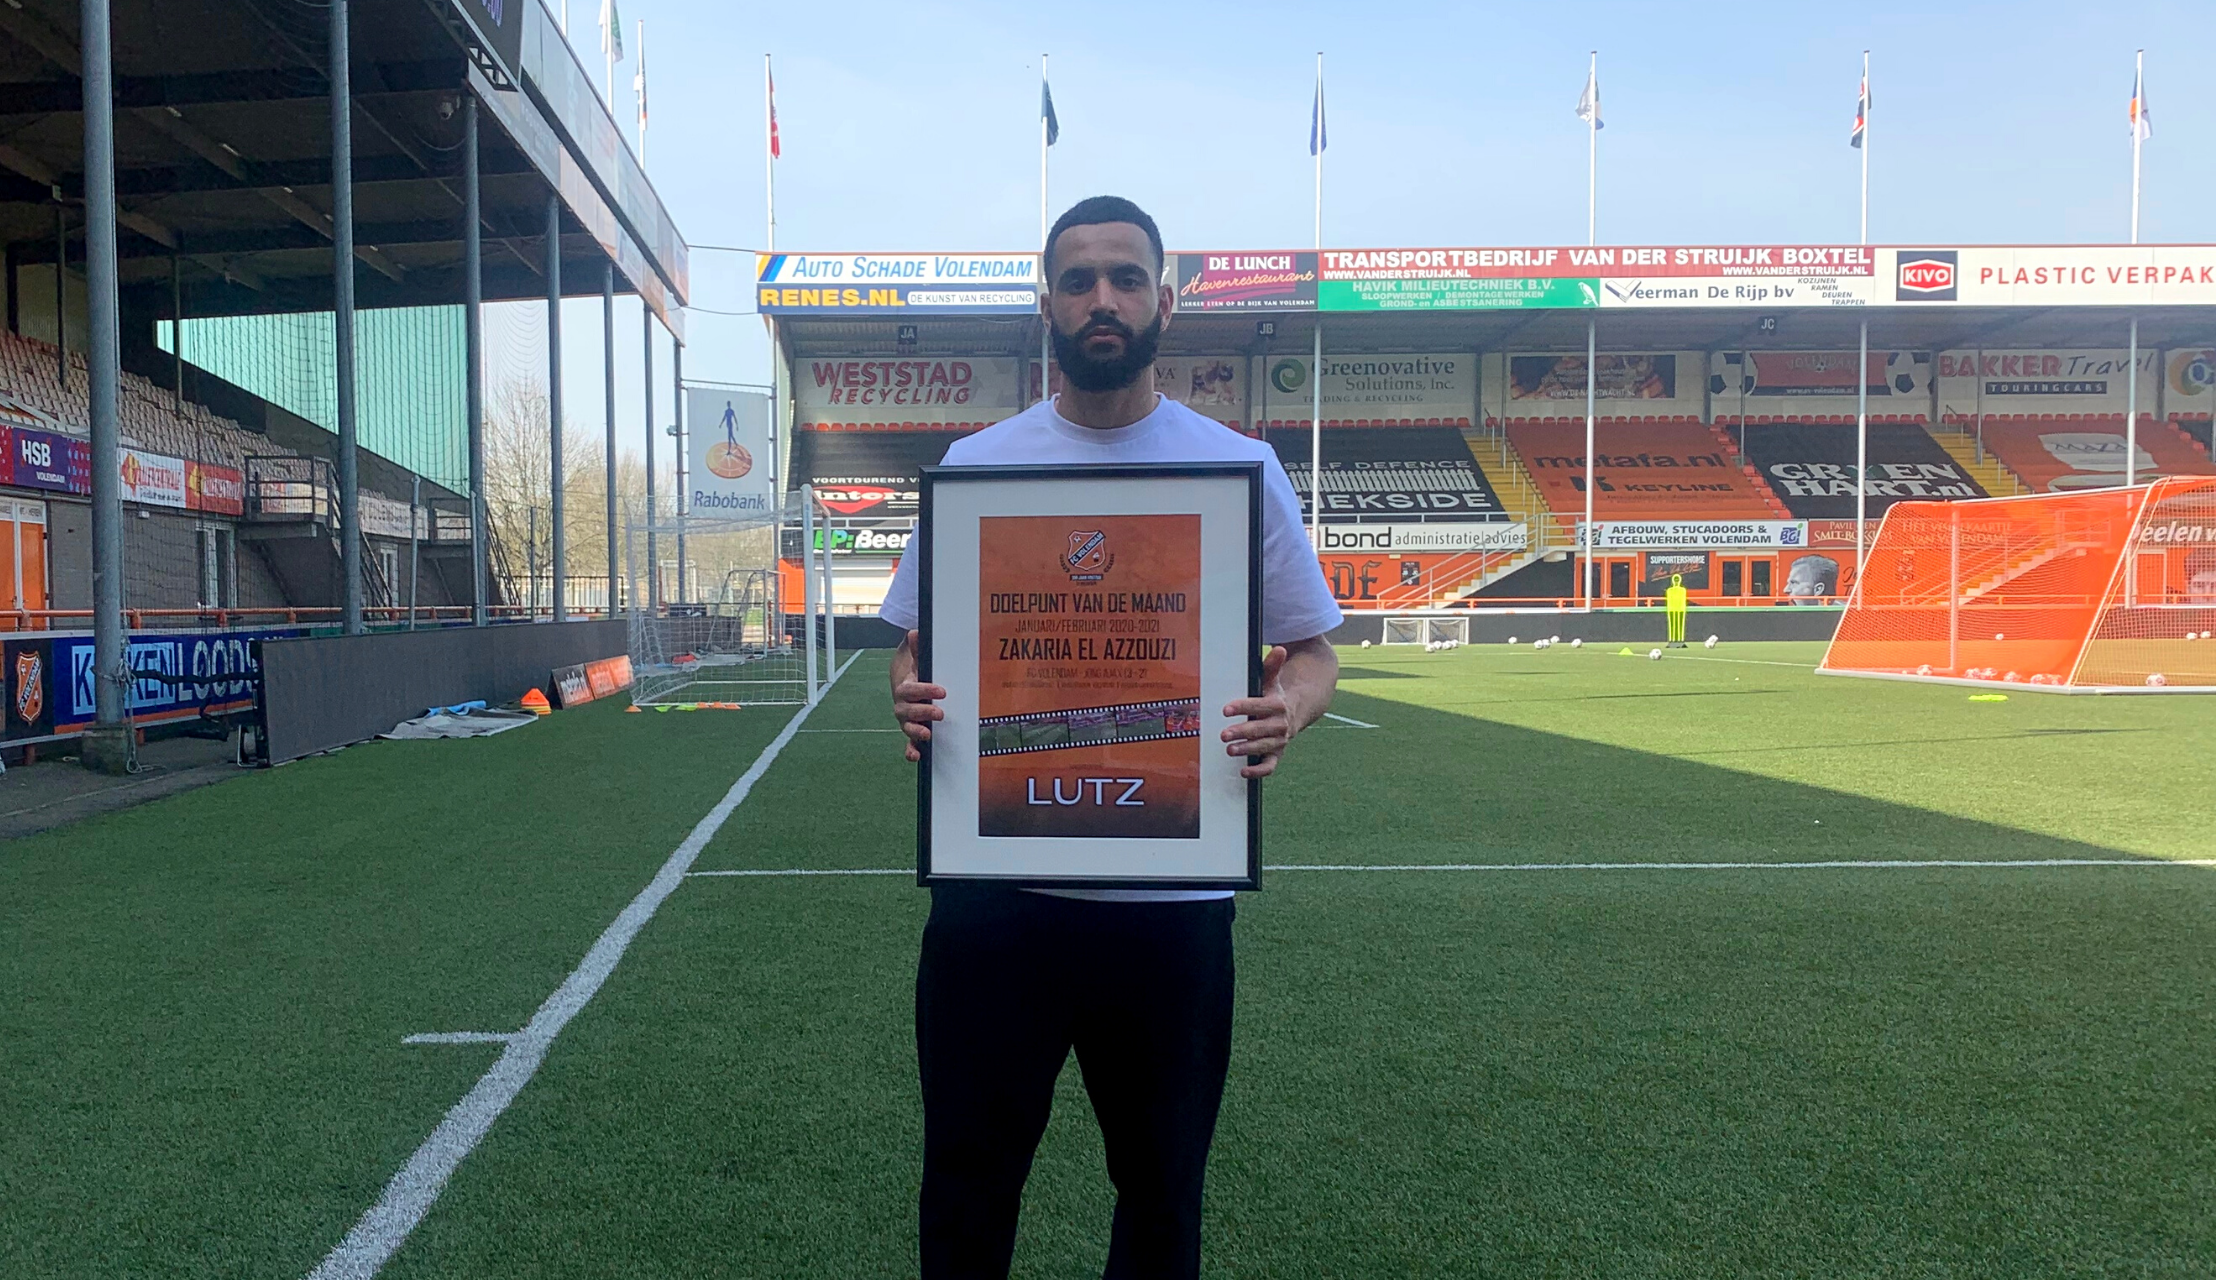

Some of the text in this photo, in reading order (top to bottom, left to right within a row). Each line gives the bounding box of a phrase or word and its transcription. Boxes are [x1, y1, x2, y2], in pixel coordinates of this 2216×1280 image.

[1208, 256, 1291, 270] DE LUNCH
[1324, 248, 1871, 269] TRANSPORTBEDRIJF VAN DER STRUIJK BOXTEL
[1323, 269, 1471, 280] WWW.VANDERSTRUIJK.NL
[1722, 266, 1868, 276] WWW.VANDERSTRUIJK.NL
[1904, 268, 1950, 283] KIVO
[1980, 266, 2215, 284] PLASTIC VERPAK
[1180, 270, 1316, 297] Havenrestaurant
[1352, 279, 1556, 292] HAVIK MILIEUTECHNIEK B.V.
[760, 288, 906, 307] RENES.NL
[910, 293, 1033, 304] DE KUNST VAN RECYCLING
[1361, 292, 1433, 300] SLOOPWERKEN
[1445, 290, 1544, 299] DEMONTAGEWERKEN
[1707, 286, 1730, 299] De
[1735, 285, 1768, 302] Rijp
[1774, 285, 1796, 298] bv
[1380, 298, 1523, 308] GROND- en ASBESTSANERING
[1259, 322, 1274, 335] JB
[1761, 318, 1775, 330] JC
[900, 329, 916, 340] JA
[1311, 357, 1455, 377] Greenovative
[1938, 354, 2062, 378] BAKKER
[812, 361, 973, 388] WESTSTAD
[1345, 377, 1454, 391] Solutions, Inc.
[1990, 383, 2103, 393] TOURINGCARS
[828, 387, 970, 405] RECYCLING
[1365, 394, 1424, 402] RECYCLING
[22, 439, 51, 468] HSB
[1533, 452, 1727, 469] metafa.nl
[1284, 460, 1471, 470] SELF DEFENCE
[36, 471, 66, 484] VOLENDAM
[1624, 483, 1735, 492] KEYLINE
[1778, 479, 1979, 497] HART.nl
[694, 490, 765, 510] Rabobank
[1611, 524, 1768, 536] AFBOUW, STUCADOORS &
[1829, 521, 1877, 530] PAVILEN
[1325, 526, 1392, 548] bond
[1608, 535, 1772, 544] TEGELWERKEN VOLENDAM
[1650, 555, 1706, 565] SUPPORTERSHOME
[990, 592, 1186, 614] DOELPUNT VAN DE MAAND
[1015, 619, 1160, 634] JANUARI/FEBRUARI 2020-2021
[998, 638, 1176, 661] ZAKARIA EL AZZOUZI
[1027, 777, 1145, 806] LUTZ
